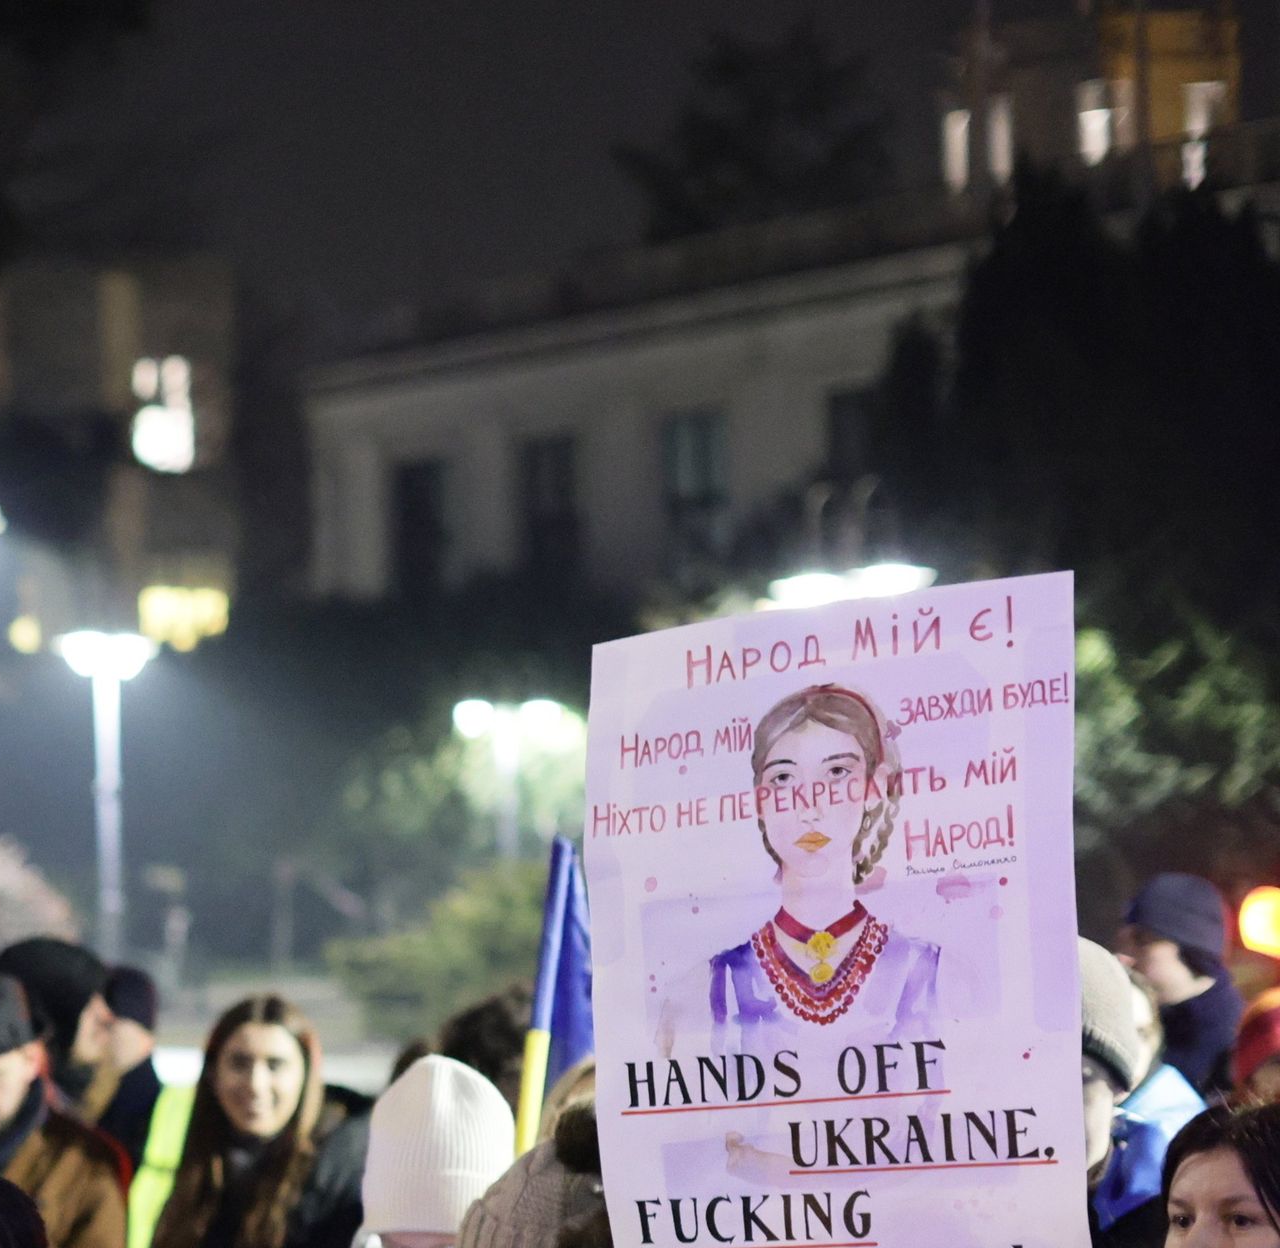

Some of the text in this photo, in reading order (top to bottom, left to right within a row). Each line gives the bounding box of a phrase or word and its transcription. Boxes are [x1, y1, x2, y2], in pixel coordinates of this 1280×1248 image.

[686, 634, 827, 689] НАРОД
[899, 671, 1071, 727] ЗАВЖДИ БУДЕ!
[620, 729, 704, 769] НАРОД
[676, 796, 710, 827] НЕ
[718, 765, 948, 823] ПЕРЕКРЕСЛИТЬ
[903, 803, 1017, 861] НАРОД!
[624, 1039, 948, 1109] HANDS OFF
[633, 1189, 874, 1246] FUCKING
